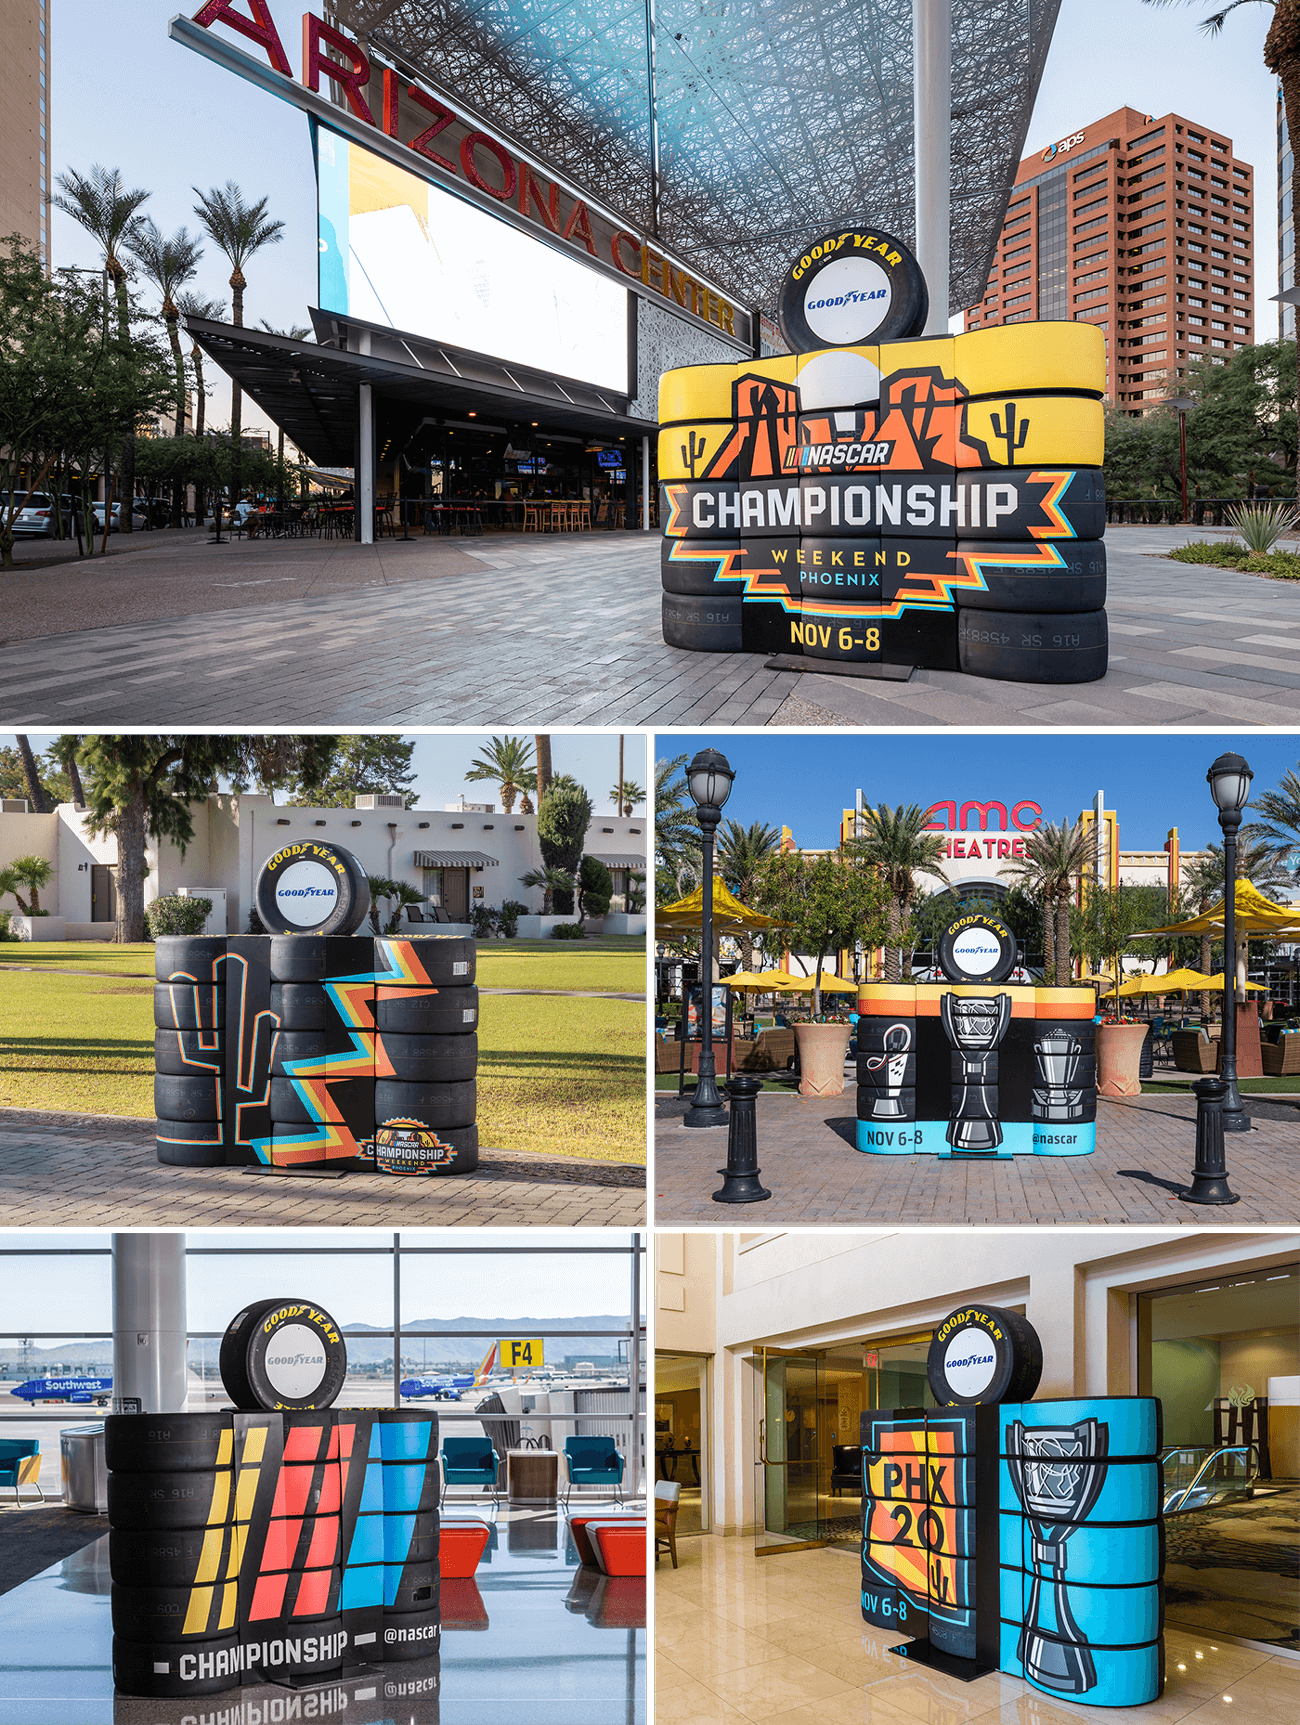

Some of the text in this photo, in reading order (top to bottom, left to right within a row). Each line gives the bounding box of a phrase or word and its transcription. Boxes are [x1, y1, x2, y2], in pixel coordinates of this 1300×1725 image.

[1058, 131, 1085, 153] aps
[191, 0, 735, 336] ARIZONA CENTER
[792, 233, 902, 280] GOODYEAR
[808, 289, 886, 310] GOODYEAR
[807, 442, 890, 465] NASCAR
[692, 482, 1019, 529] CHAMPIONSHIP
[771, 549, 911, 567] WEEKEND
[800, 571, 879, 587] PHOENIX
[790, 621, 880, 651] NOV 6-8
[268, 843, 346, 875] GOODYEAR
[278, 887, 334, 898] GOODYEAR
[948, 915, 1008, 938] GOODYEAR
[955, 946, 999, 955] GOODYEAR
[866, 1130, 923, 1146] NOV 6-8
[1032, 1133, 1078, 1145] @nascar
[366, 1144, 444, 1160] CHAMPIONSHIP
[385, 1158, 425, 1166] WEEKEND
[264, 1305, 340, 1344] GOODYEAR
[937, 1309, 1003, 1343] GOODYEAR
[267, 1353, 324, 1366] GOODYEAR
[511, 1342, 533, 1366] F4
[946, 1354, 994, 1369] GOODYEAR
[45, 1380, 102, 1390] Southwest
[883, 1463, 950, 1505] PHX
[890, 1505, 945, 1552] 20
[881, 1597, 908, 1621] 6-8
[384, 1624, 438, 1644] @nascar
[179, 1630, 348, 1681] CHAMPIONSHIP
